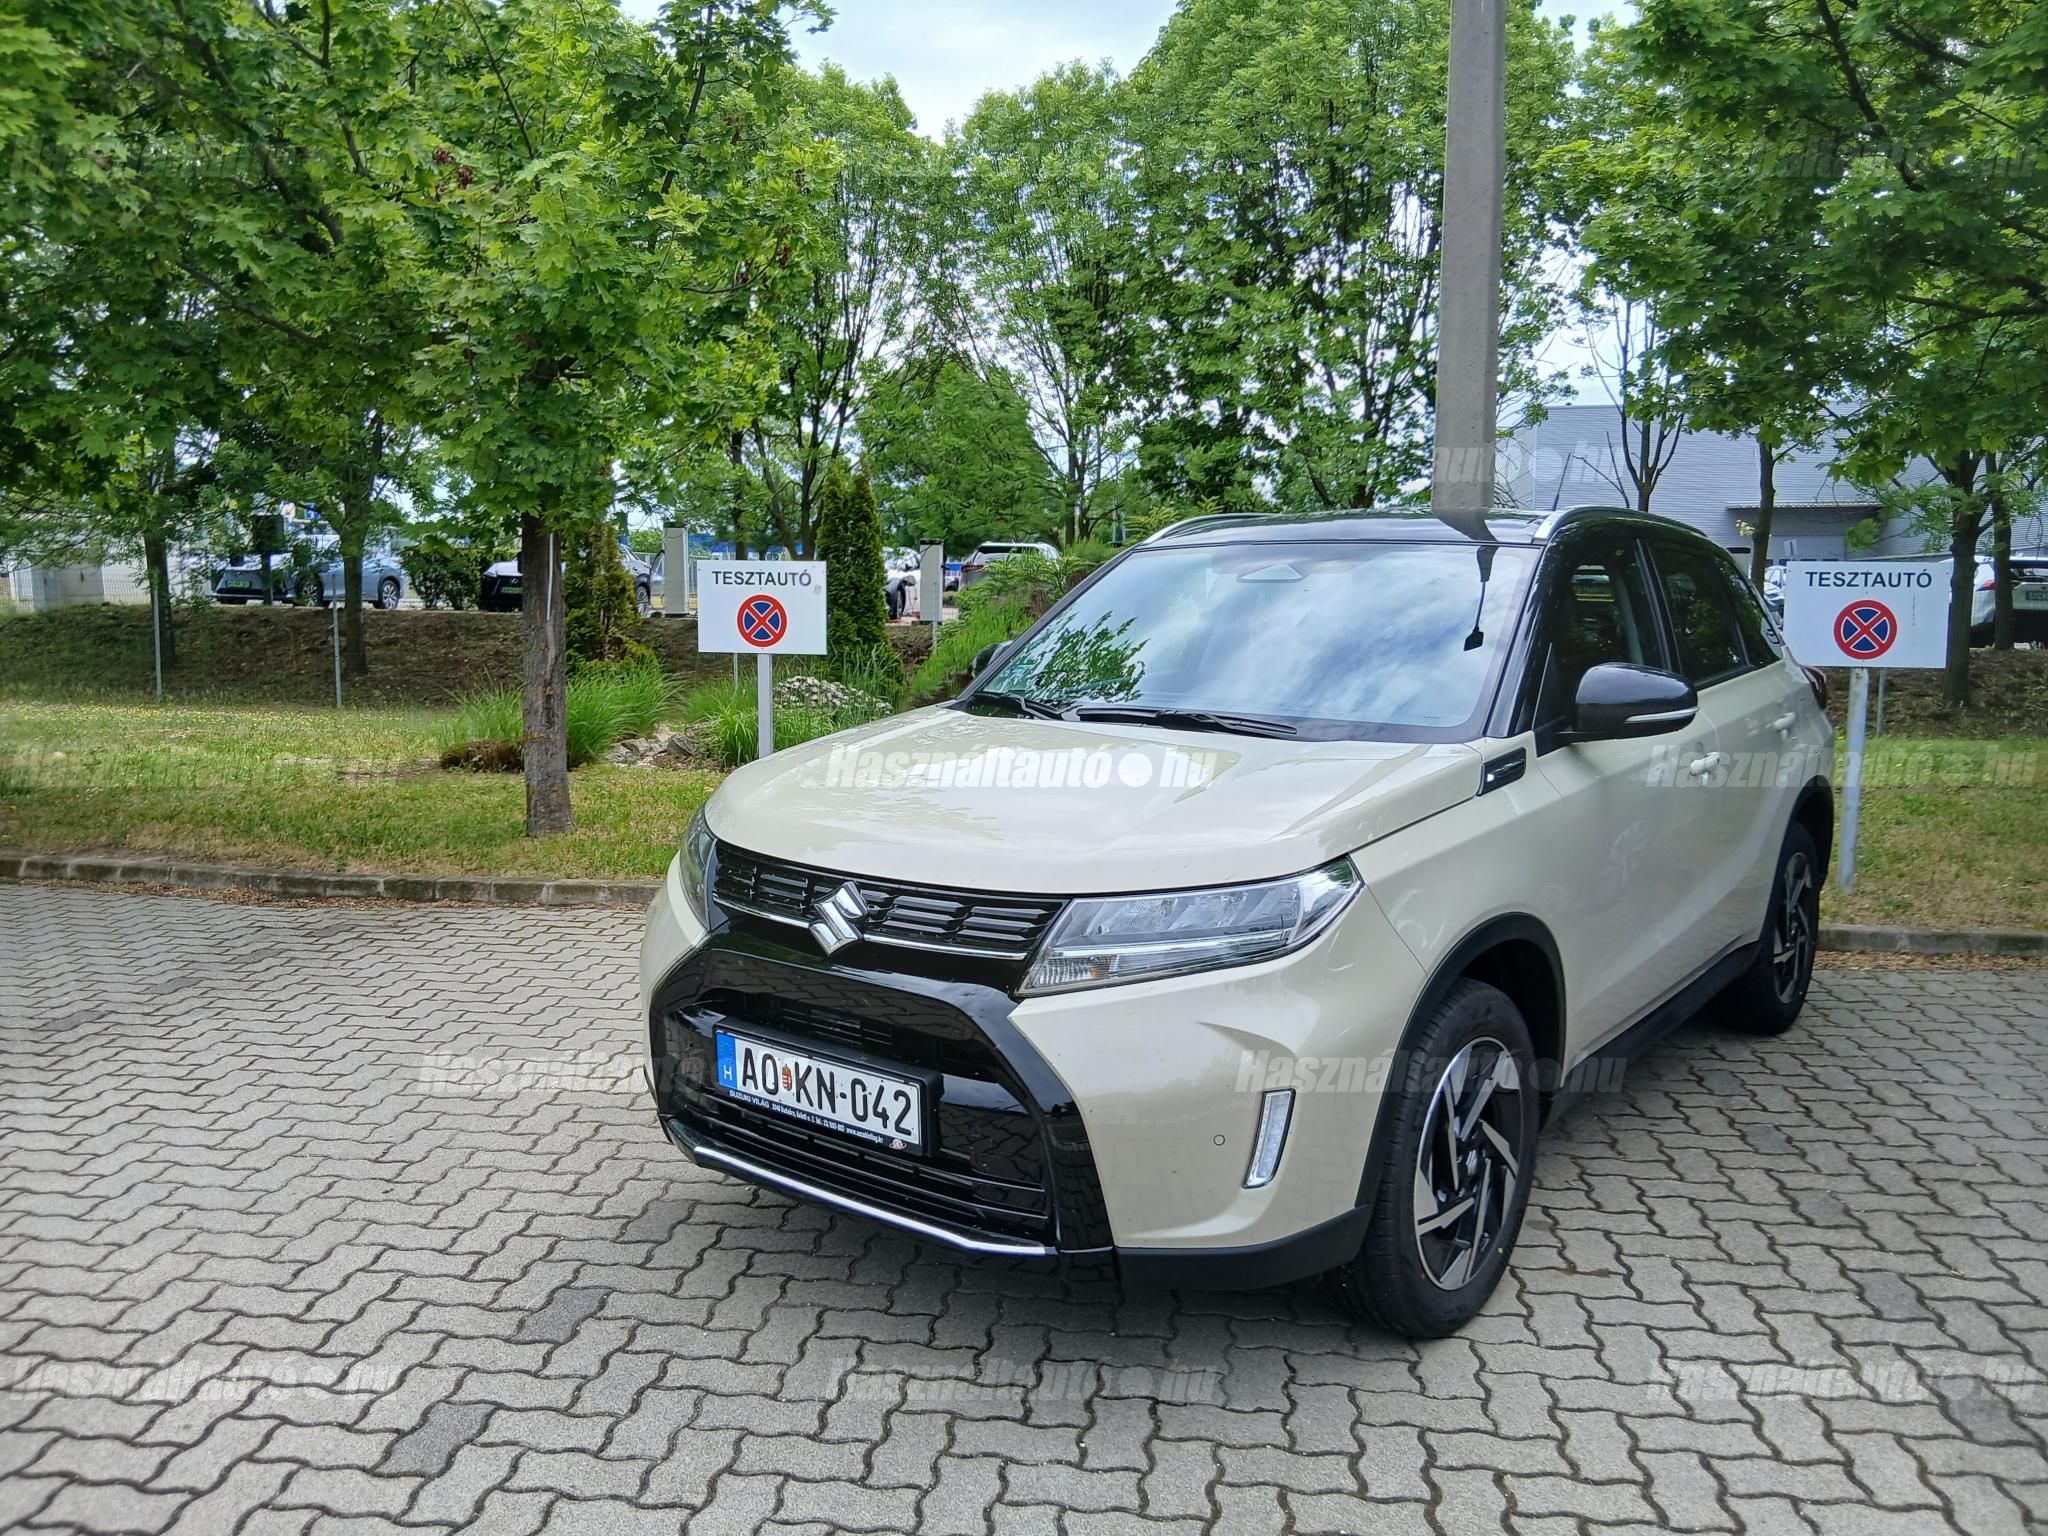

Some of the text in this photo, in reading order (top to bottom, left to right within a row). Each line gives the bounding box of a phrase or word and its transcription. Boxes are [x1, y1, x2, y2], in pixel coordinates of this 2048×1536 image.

[711, 569, 812, 587] TESZTAUTÓ
[1805, 568, 1932, 588] TESZTAUTÓ
[723, 1064, 733, 1082] H
[729, 1089, 751, 1103] SUZUKI
[794, 1061, 912, 1136] KN-042
